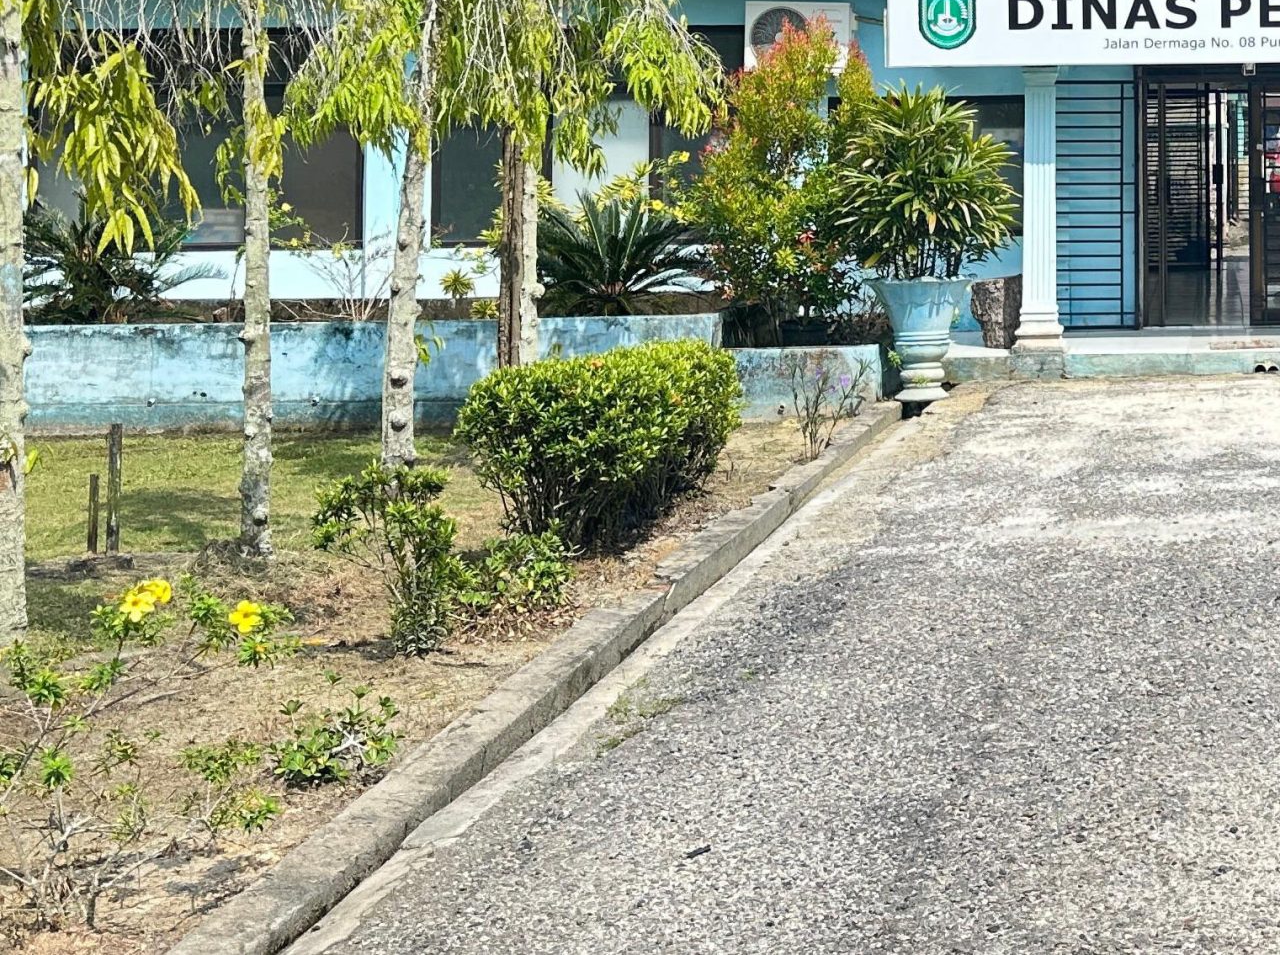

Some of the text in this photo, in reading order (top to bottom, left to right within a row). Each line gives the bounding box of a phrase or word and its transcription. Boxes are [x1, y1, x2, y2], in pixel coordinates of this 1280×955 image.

[1104, 38, 1139, 50] Jalan
[1144, 38, 1206, 51] Dermaga
[1211, 37, 1234, 48] No.
[1239, 37, 1256, 48] 08
